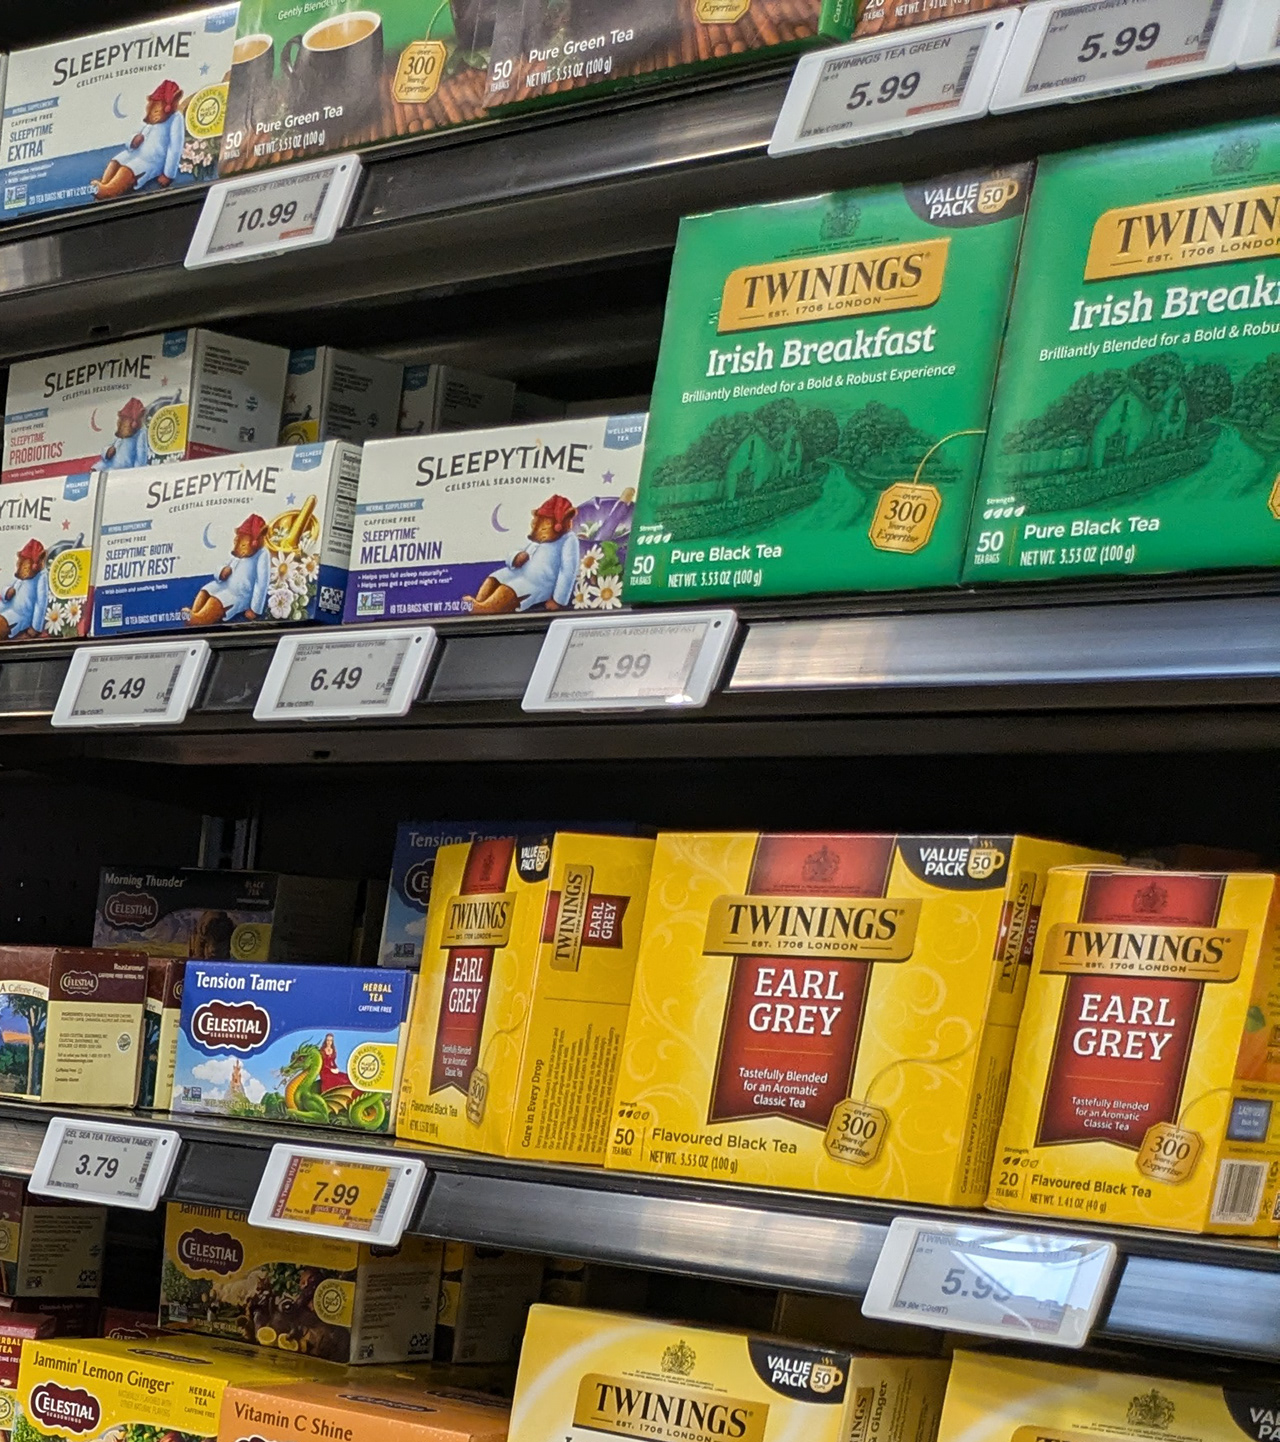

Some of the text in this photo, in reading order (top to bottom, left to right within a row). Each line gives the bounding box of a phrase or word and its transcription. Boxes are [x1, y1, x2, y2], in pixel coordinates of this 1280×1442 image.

[528, 27, 634, 63] Pure Green Tea
[1078, 25, 1161, 63] 5.99
[51, 32, 190, 86] SLEEPYTIME
[924, 184, 979, 206] VALUE
[237, 201, 298, 235] 10.99
[929, 202, 974, 220] PACK
[744, 253, 923, 310] TWININGS
[768, 296, 882, 319] EST. 1706 LONDON
[706, 325, 936, 377] Irish Breakfast
[681, 363, 955, 405] Brilliantly Blended for a Bold & Robust Experience
[8, 442, 63, 465] PROBIOTICS
[415, 443, 587, 488] SLEEPYTIME
[147, 467, 277, 510] SLEEPYTIME
[884, 501, 927, 524] 300
[359, 542, 443, 565] MELATONIN
[632, 555, 654, 574] 50
[671, 544, 782, 566] Pure Black Tea
[104, 558, 175, 580] BEAUTY REST
[310, 666, 363, 693] 6.49
[729, 904, 898, 942] TWININGS
[196, 972, 293, 993] Tension Tamer
[753, 967, 845, 1001] EARL
[199, 1011, 264, 1034] CELESTIAL
[747, 1004, 842, 1037] GREY
[651, 1128, 798, 1154] Flavoured Black Tea
[75, 1154, 119, 1180] 3.79
[313, 1182, 360, 1207] 7.99
[32, 1350, 171, 1396] Jammin' Lemon Ginger
[233, 1401, 354, 1442] Vitamin C Shine
